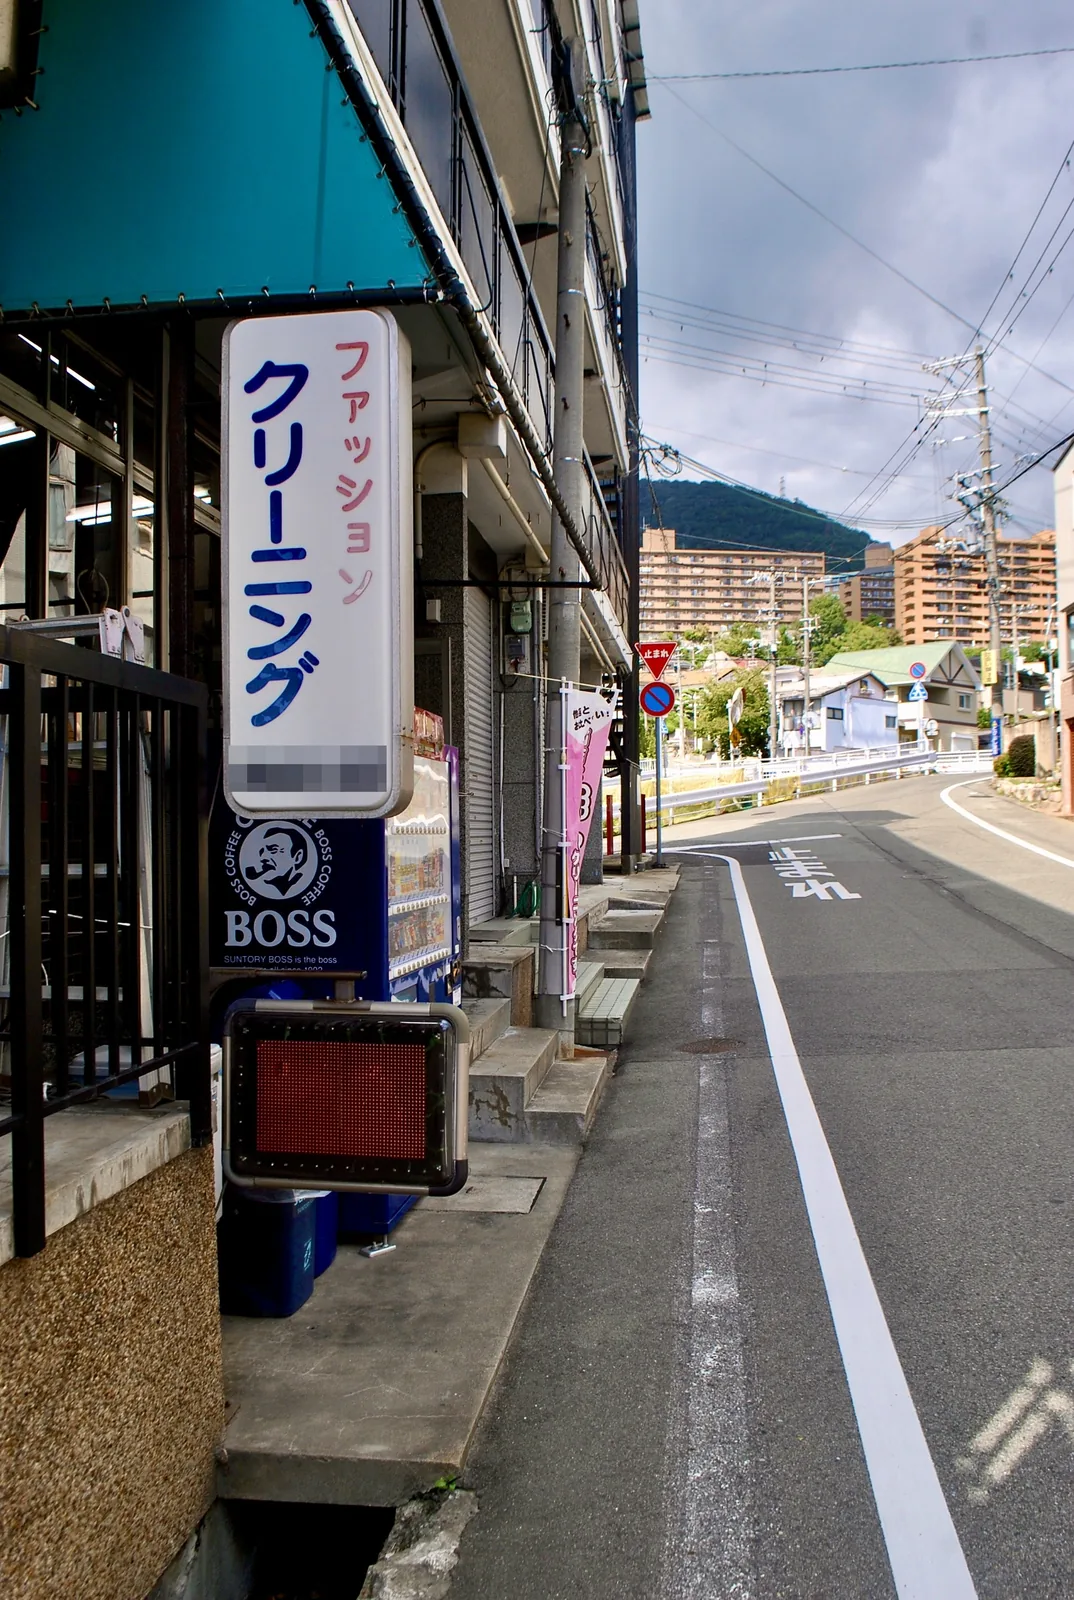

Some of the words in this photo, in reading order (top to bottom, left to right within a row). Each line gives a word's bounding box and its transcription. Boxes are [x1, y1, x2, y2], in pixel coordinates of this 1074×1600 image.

[335, 341, 373, 605] ファッション
[243, 360, 320, 728] クリーニング
[644, 649, 669, 659] 止まれ
[225, 830, 242, 877] COFFEE
[314, 829, 333, 862] BOSS
[231, 878, 257, 906] BOSS
[301, 865, 332, 906] COFFEE
[768, 846, 862, 900] 止まれ
[224, 909, 337, 947] BOSS
[223, 955, 266, 964] SUNTORY
[268, 955, 293, 964] BOSS
[294, 955, 302, 964] is
[303, 955, 316, 964] the
[318, 955, 337, 964] boss
